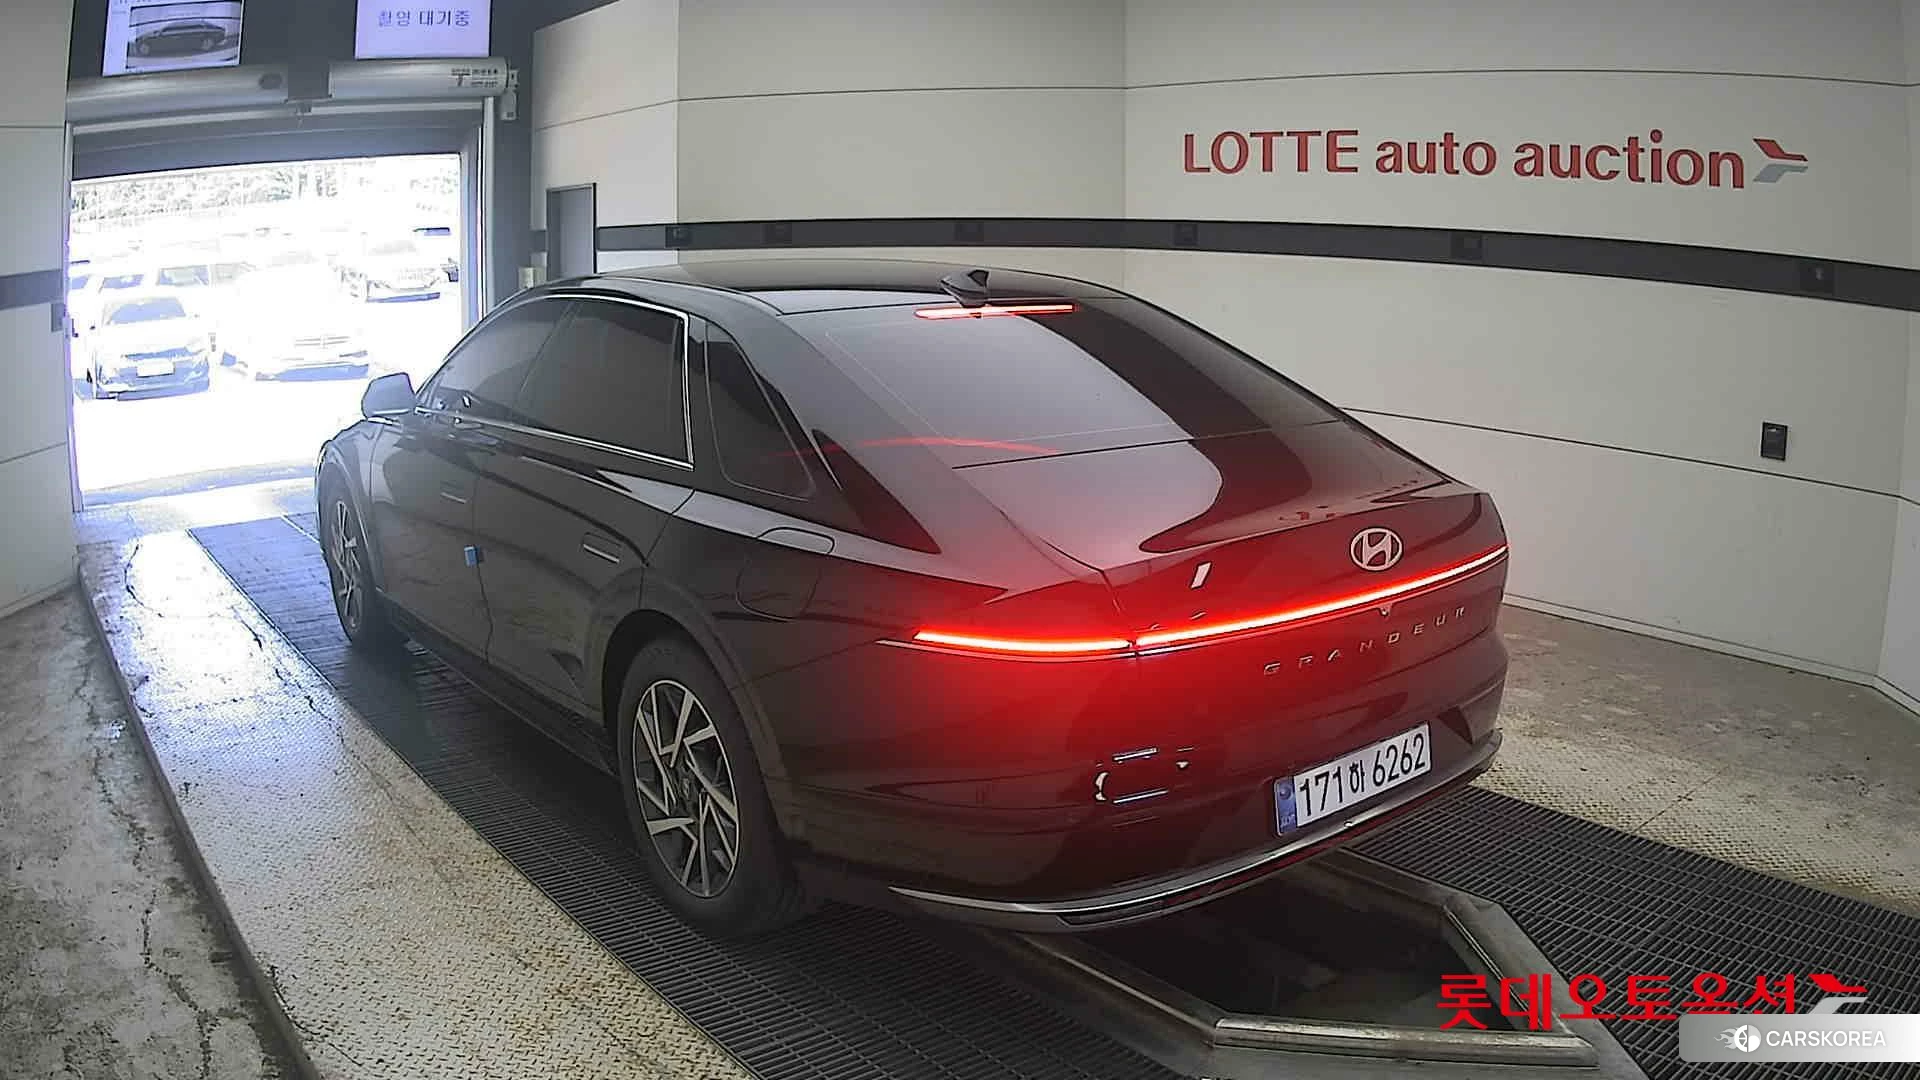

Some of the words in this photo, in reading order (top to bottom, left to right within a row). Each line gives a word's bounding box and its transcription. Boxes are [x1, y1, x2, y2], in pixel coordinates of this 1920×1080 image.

[419, 10, 469, 27] 대기중
[1184, 130, 1359, 174] LOTTE
[1375, 132, 1497, 176] auto
[1513, 129, 1744, 189] auction
[1263, 606, 1466, 676] GRANDEUR
[1299, 759, 1366, 817] 171하
[1372, 732, 1426, 787] 6262
